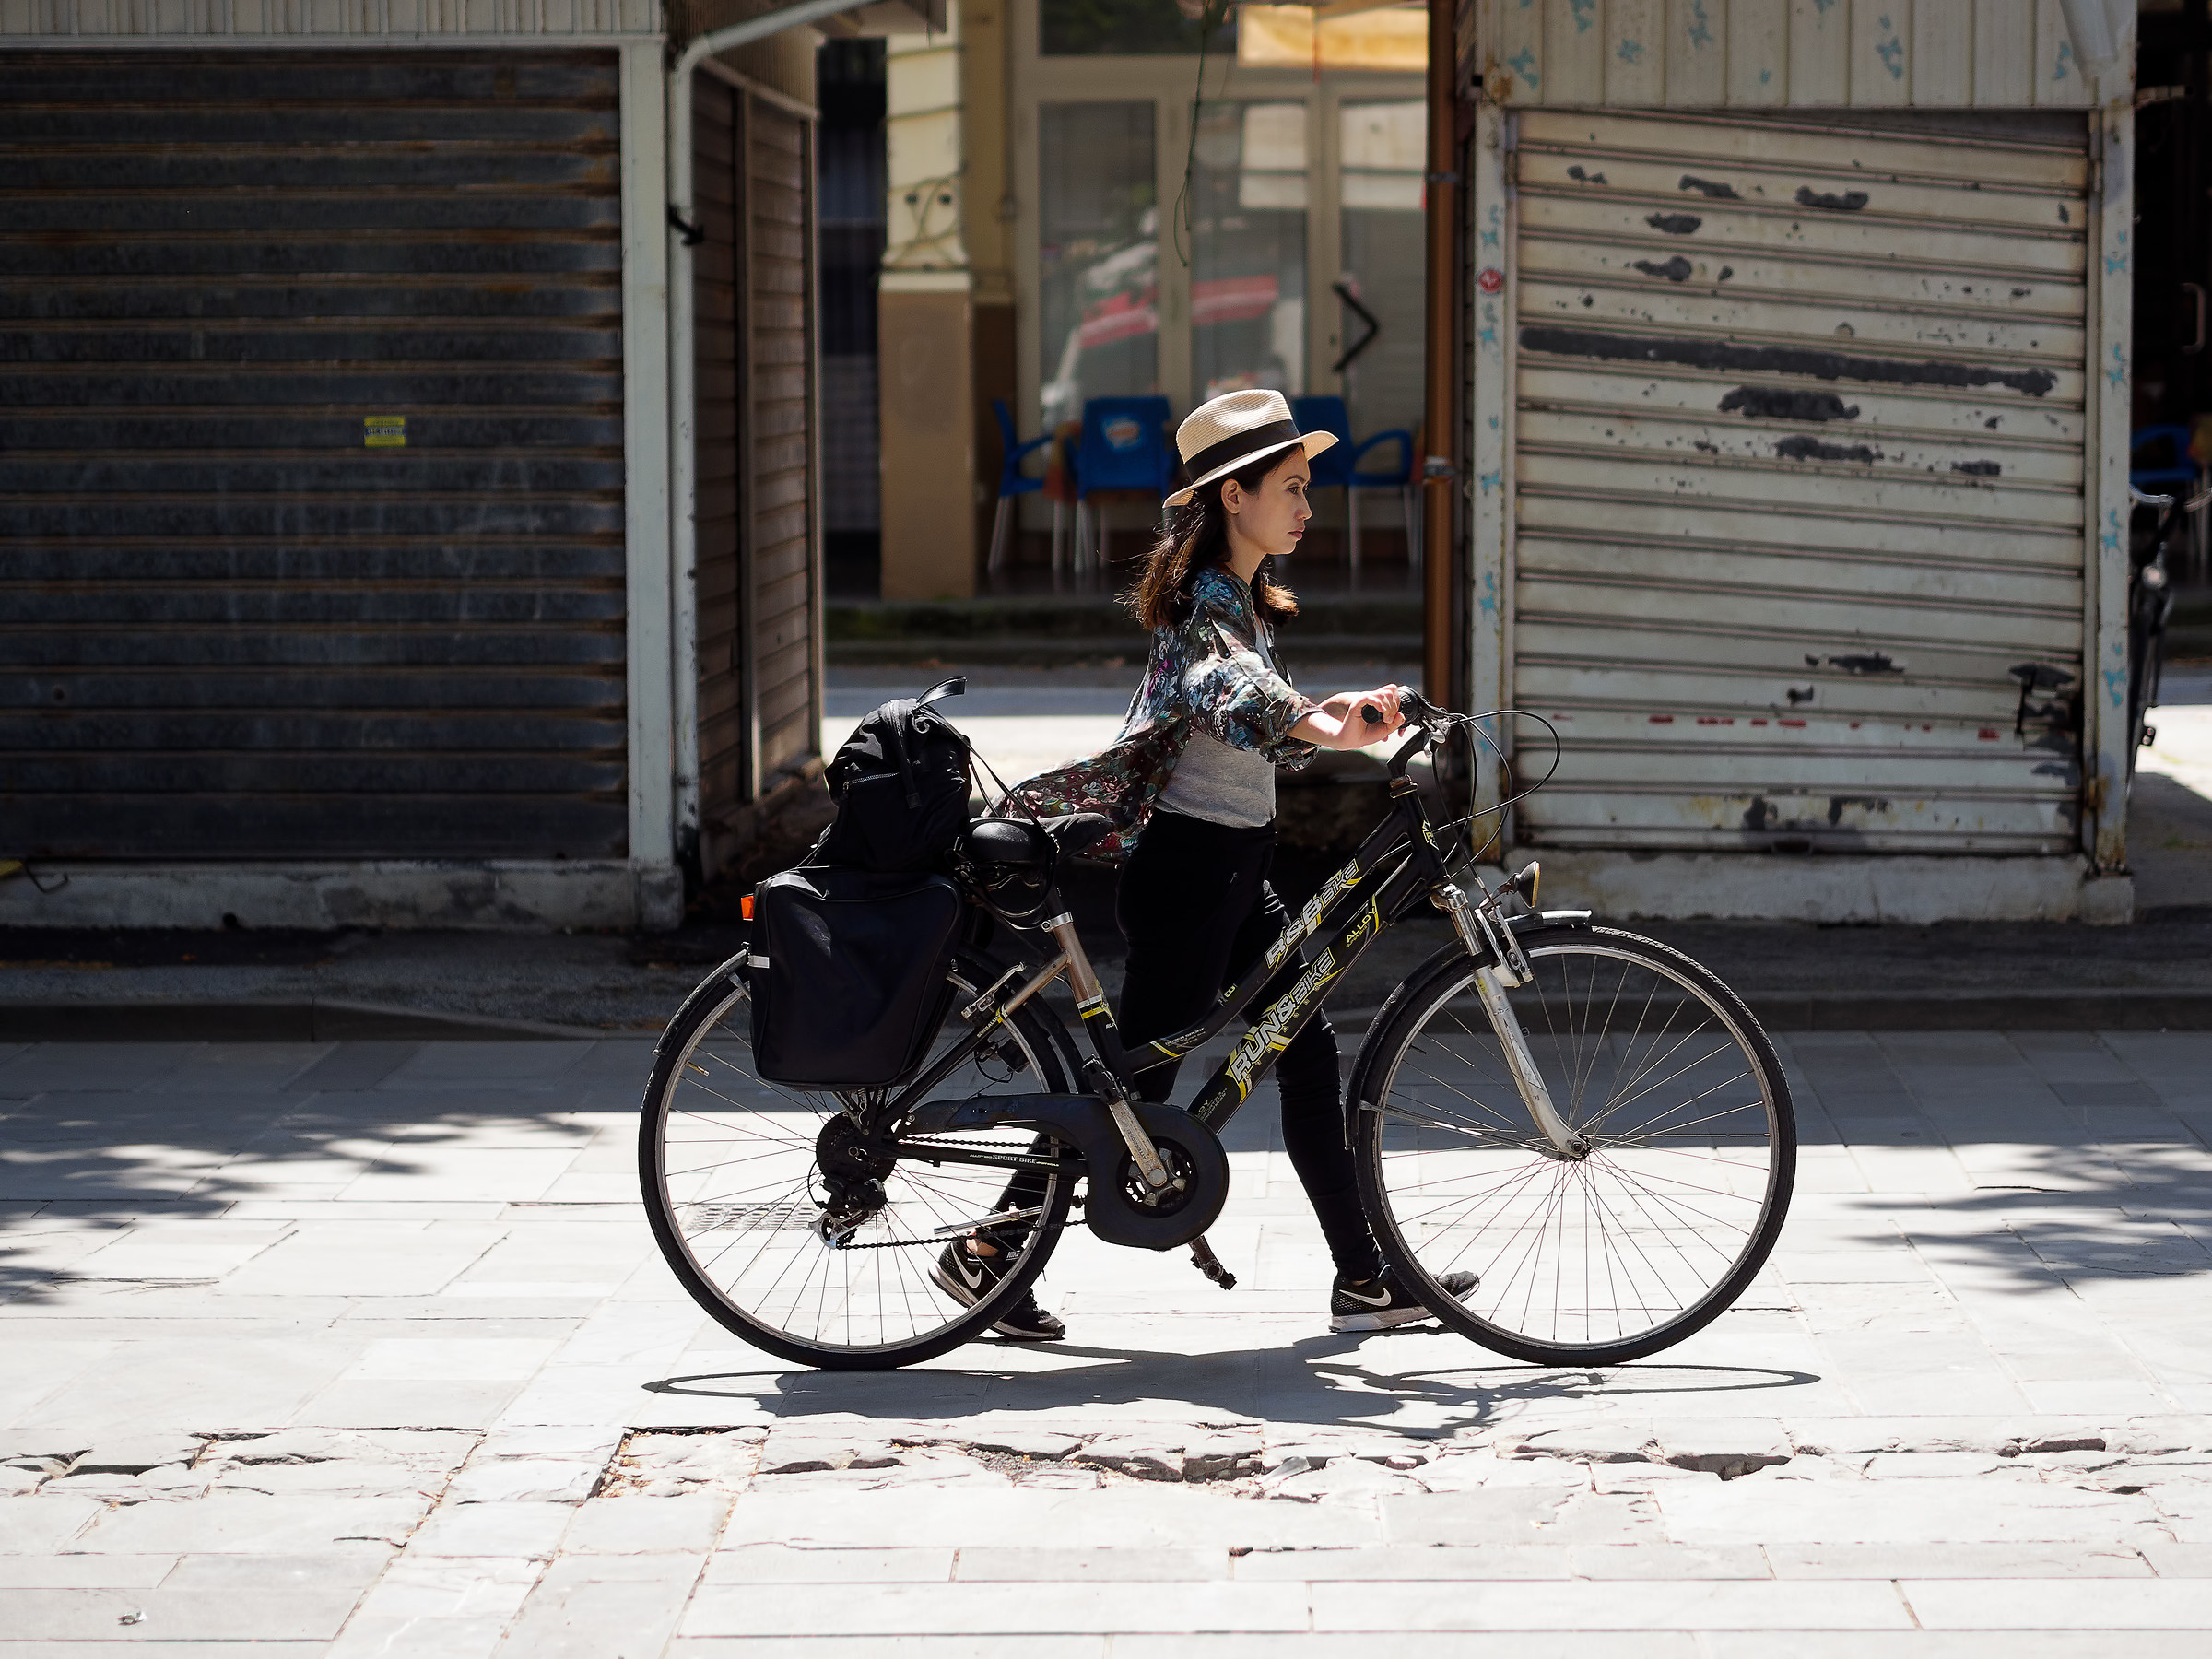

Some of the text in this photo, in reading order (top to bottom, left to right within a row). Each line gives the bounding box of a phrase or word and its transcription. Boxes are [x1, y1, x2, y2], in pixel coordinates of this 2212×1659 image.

[1322, 862, 1358, 905] BIKE
[1347, 907, 1375, 943] ALLOY
[992, 1154, 1018, 1162] SPORT
